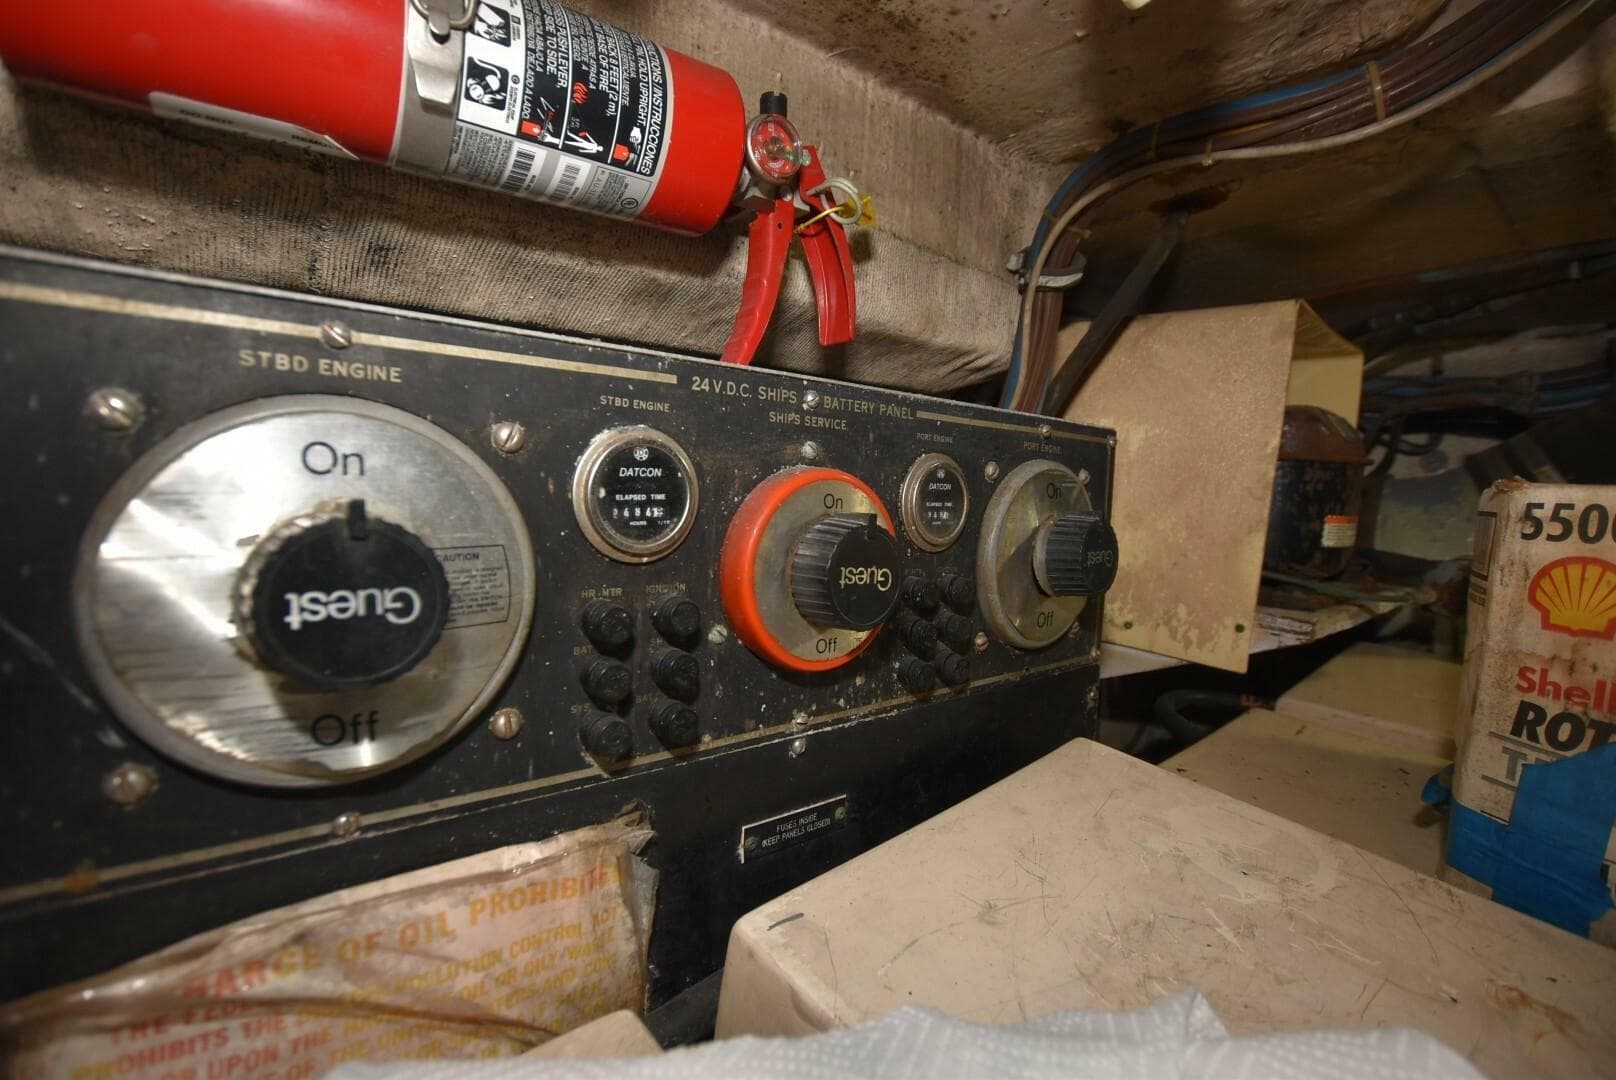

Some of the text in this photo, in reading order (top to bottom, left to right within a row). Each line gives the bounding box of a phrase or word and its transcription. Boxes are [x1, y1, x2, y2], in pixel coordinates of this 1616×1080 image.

[545, 35, 556, 49] TO
[556, 26, 568, 53] PUSH
[545, 48, 557, 75] SIDE.
[554, 52, 567, 88] LEVER,
[599, 54, 608, 69] OF
[598, 68, 608, 92] FIRE
[608, 64, 619, 91] FEET
[239, 350, 403, 382] STBD ENGINE
[600, 396, 671, 413] STBD ENGINE
[758, 386, 797, 404] SHIPS
[824, 396, 875, 414] BATTERY
[880, 403, 914, 420] PANEL
[769, 411, 847, 430] SHIPS SERVICE
[302, 441, 365, 477] On
[619, 467, 662, 477] DATCON
[929, 483, 952, 491] DATCON
[1046, 482, 1062, 499] On
[823, 493, 843, 509] On
[1520, 502, 1616, 545] 550
[1087, 551, 1113, 567] Guest
[839, 566, 892, 591] Guest
[283, 586, 422, 631] Guest
[1037, 611, 1054, 628] Off
[816, 638, 837, 654] Off
[311, 710, 379, 746] Off
[336, 931, 383, 963] OF
[398, 910, 457, 951] OIL
